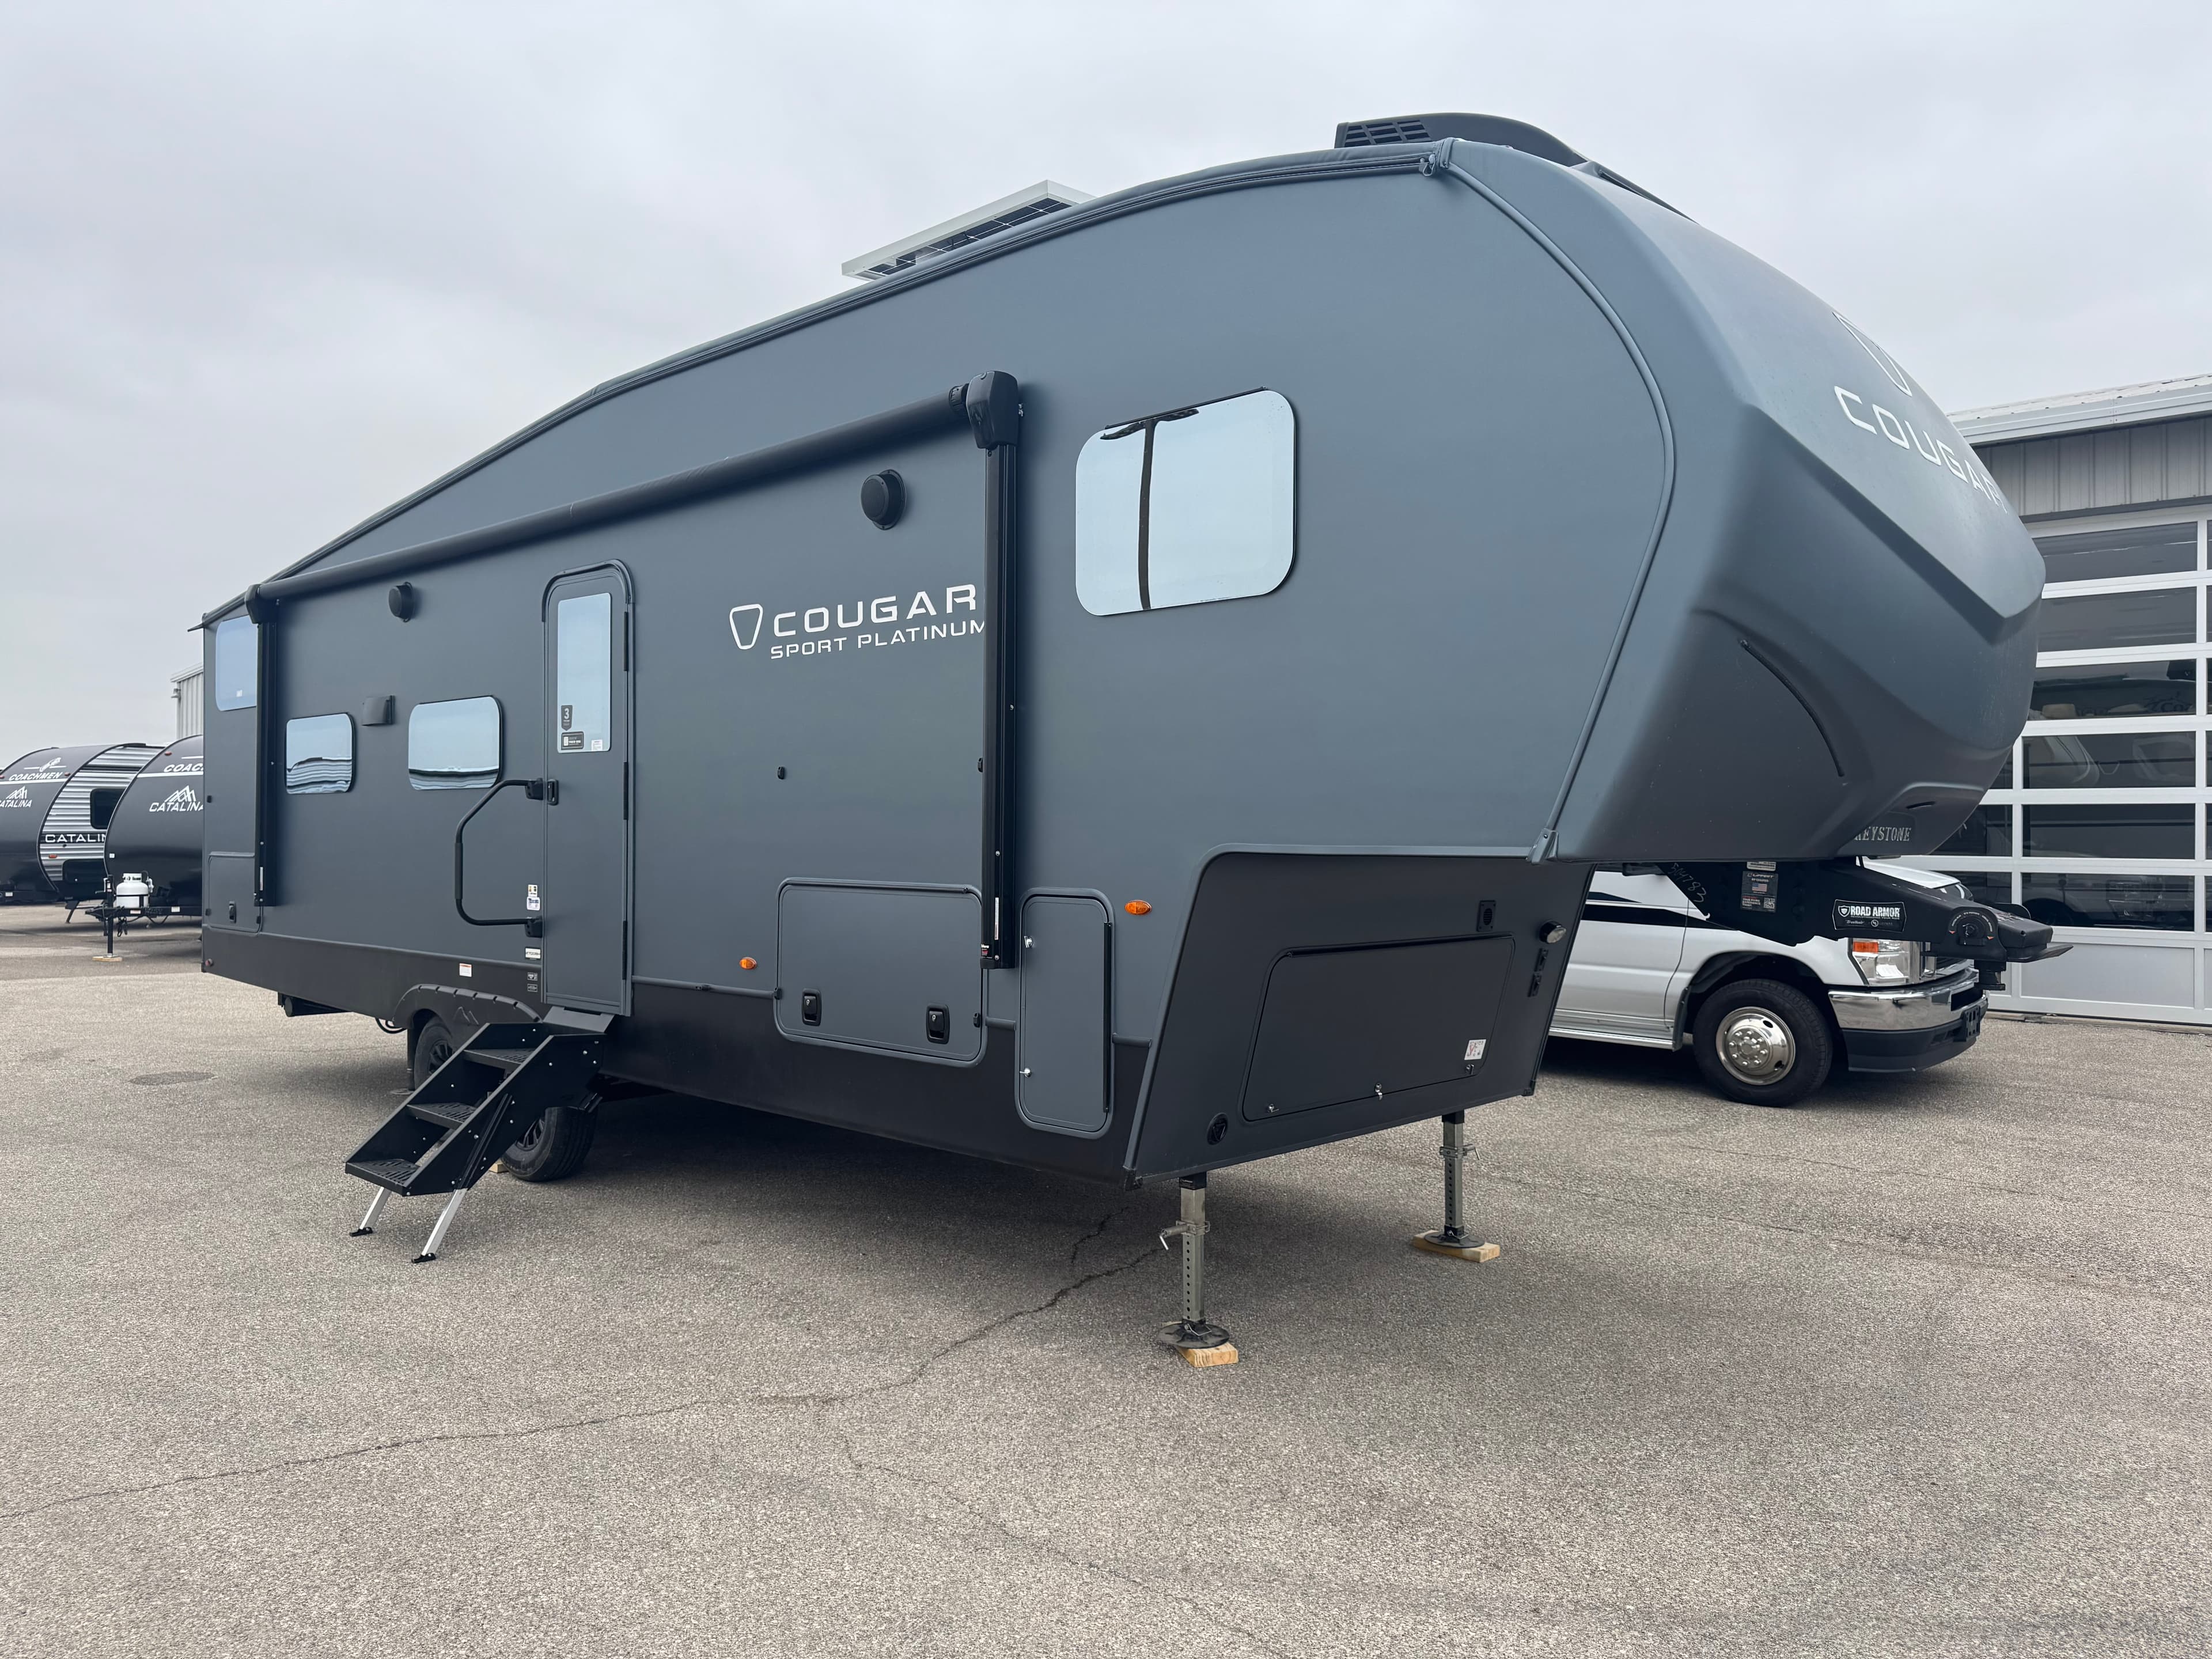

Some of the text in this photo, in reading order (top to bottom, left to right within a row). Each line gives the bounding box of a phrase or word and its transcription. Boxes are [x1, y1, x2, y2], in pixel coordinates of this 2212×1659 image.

[1834, 385, 2008, 514] COUGAR
[774, 584, 976, 637] COUGAR
[770, 620, 984, 660] SPORT PLATINUM
[9, 771, 63, 782] COACHMEN
[164, 763, 203, 772] COAC
[1850, 906, 1900, 918] ROAD ARMOR
